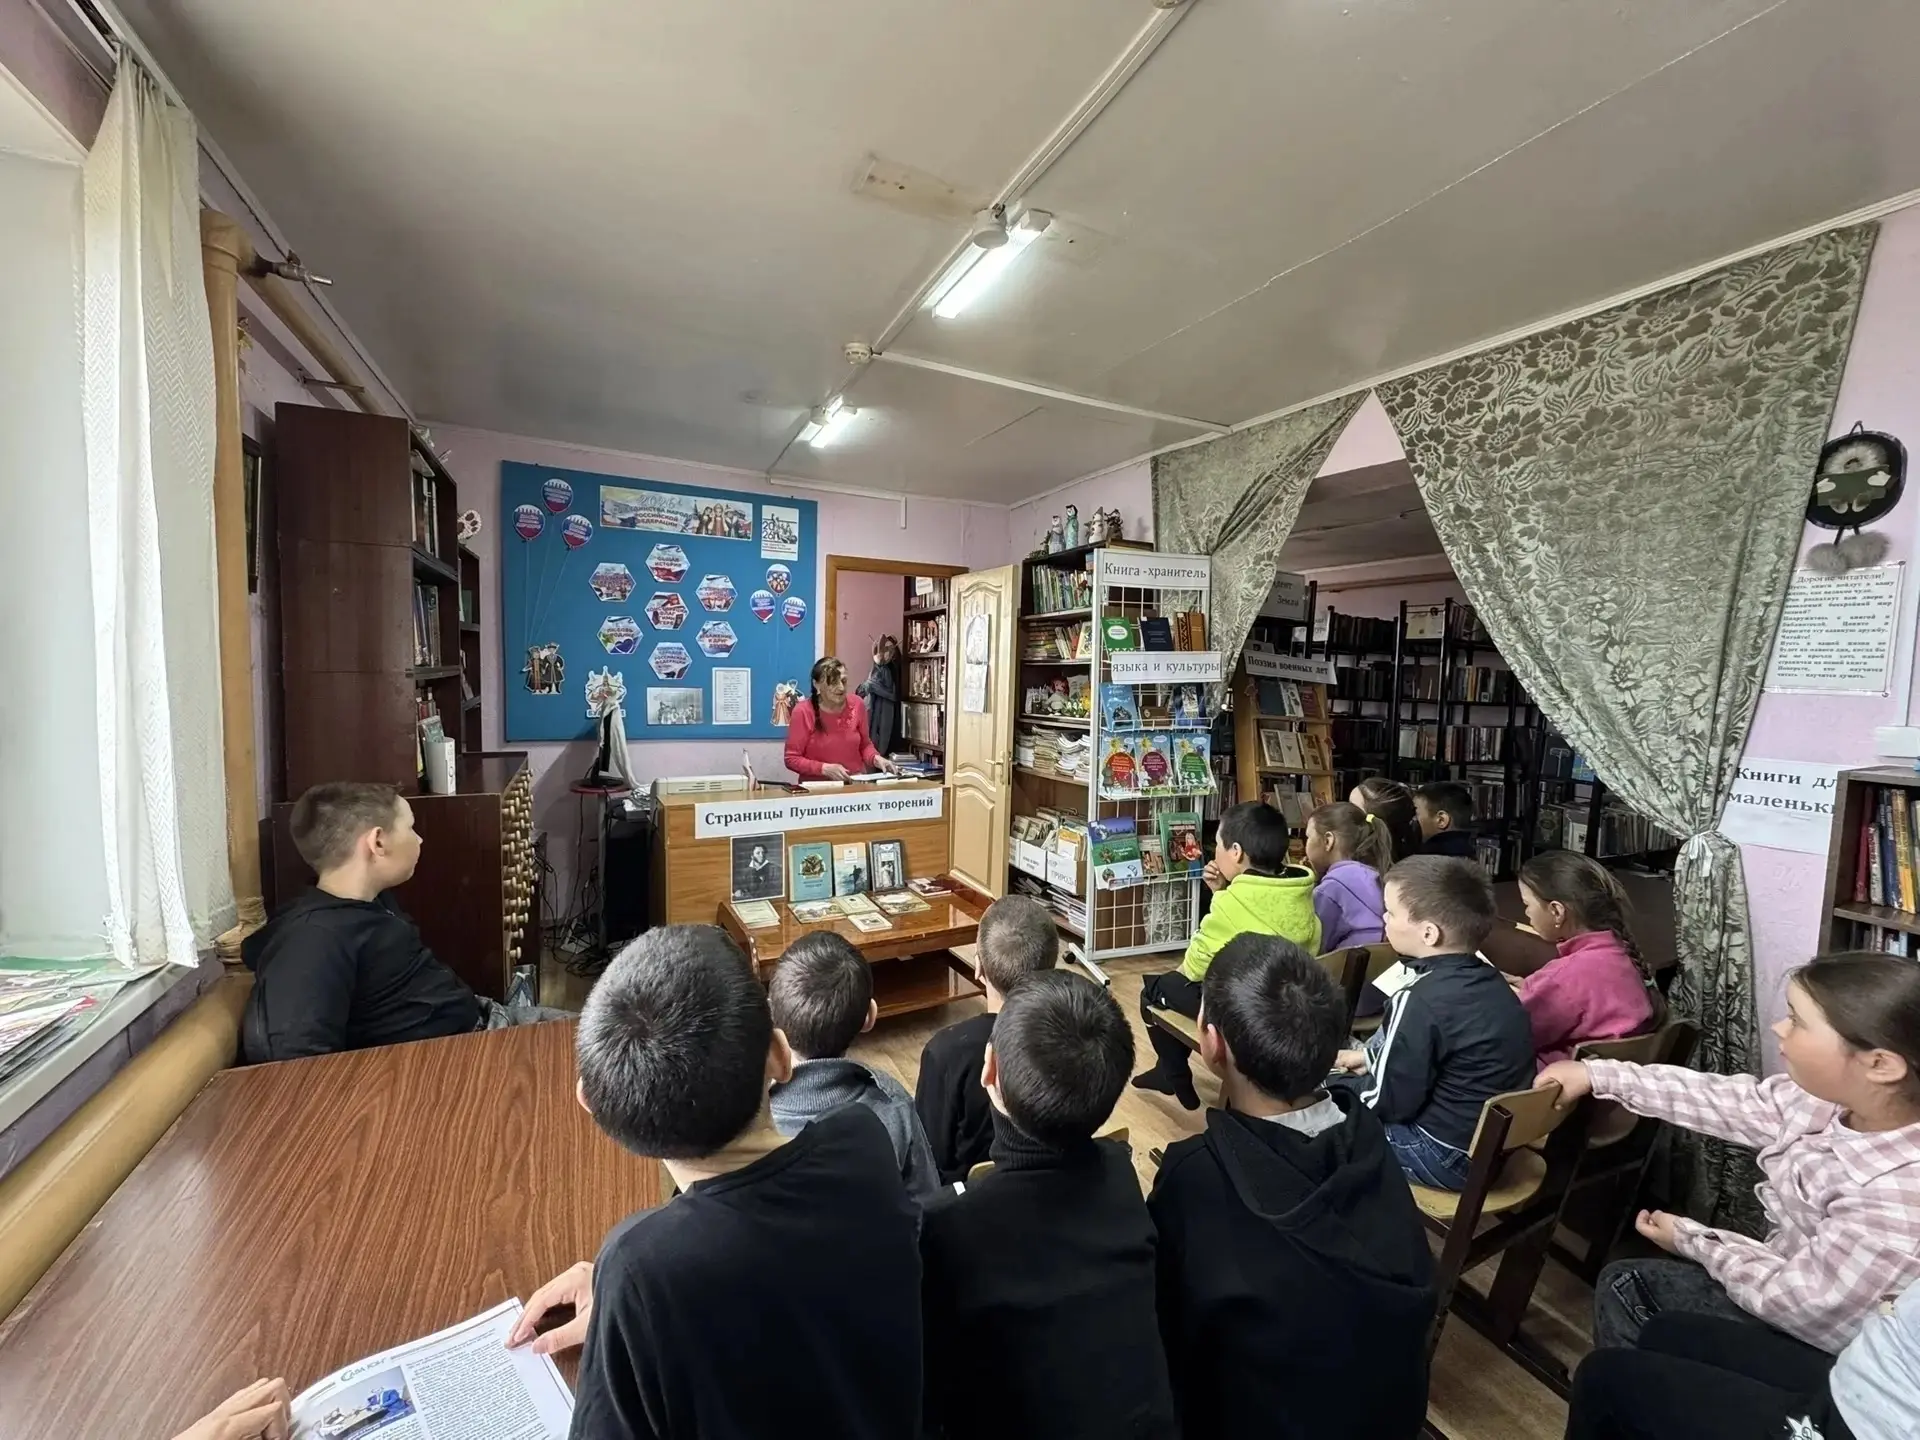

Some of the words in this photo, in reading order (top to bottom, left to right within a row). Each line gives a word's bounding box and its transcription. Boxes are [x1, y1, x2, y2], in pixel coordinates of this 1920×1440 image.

[1104, 562, 1140, 576] Книга
[1796, 576, 1835, 584] Дорогие
[1837, 572, 1885, 581] читатели!
[1112, 662, 1148, 672] языка
[1153, 662, 1161, 671] и
[1166, 661, 1220, 674] культуры
[1247, 655, 1277, 668] Поэзия
[1279, 662, 1312, 673] военных
[1315, 667, 1328, 675] лет
[1736, 767, 1801, 785] Книги
[1812, 777, 1837, 789] дл
[705, 809, 783, 827] Страницы
[789, 801, 872, 819] Пушкинских
[877, 796, 934, 810] творений
[1728, 792, 1835, 814] маленьк
